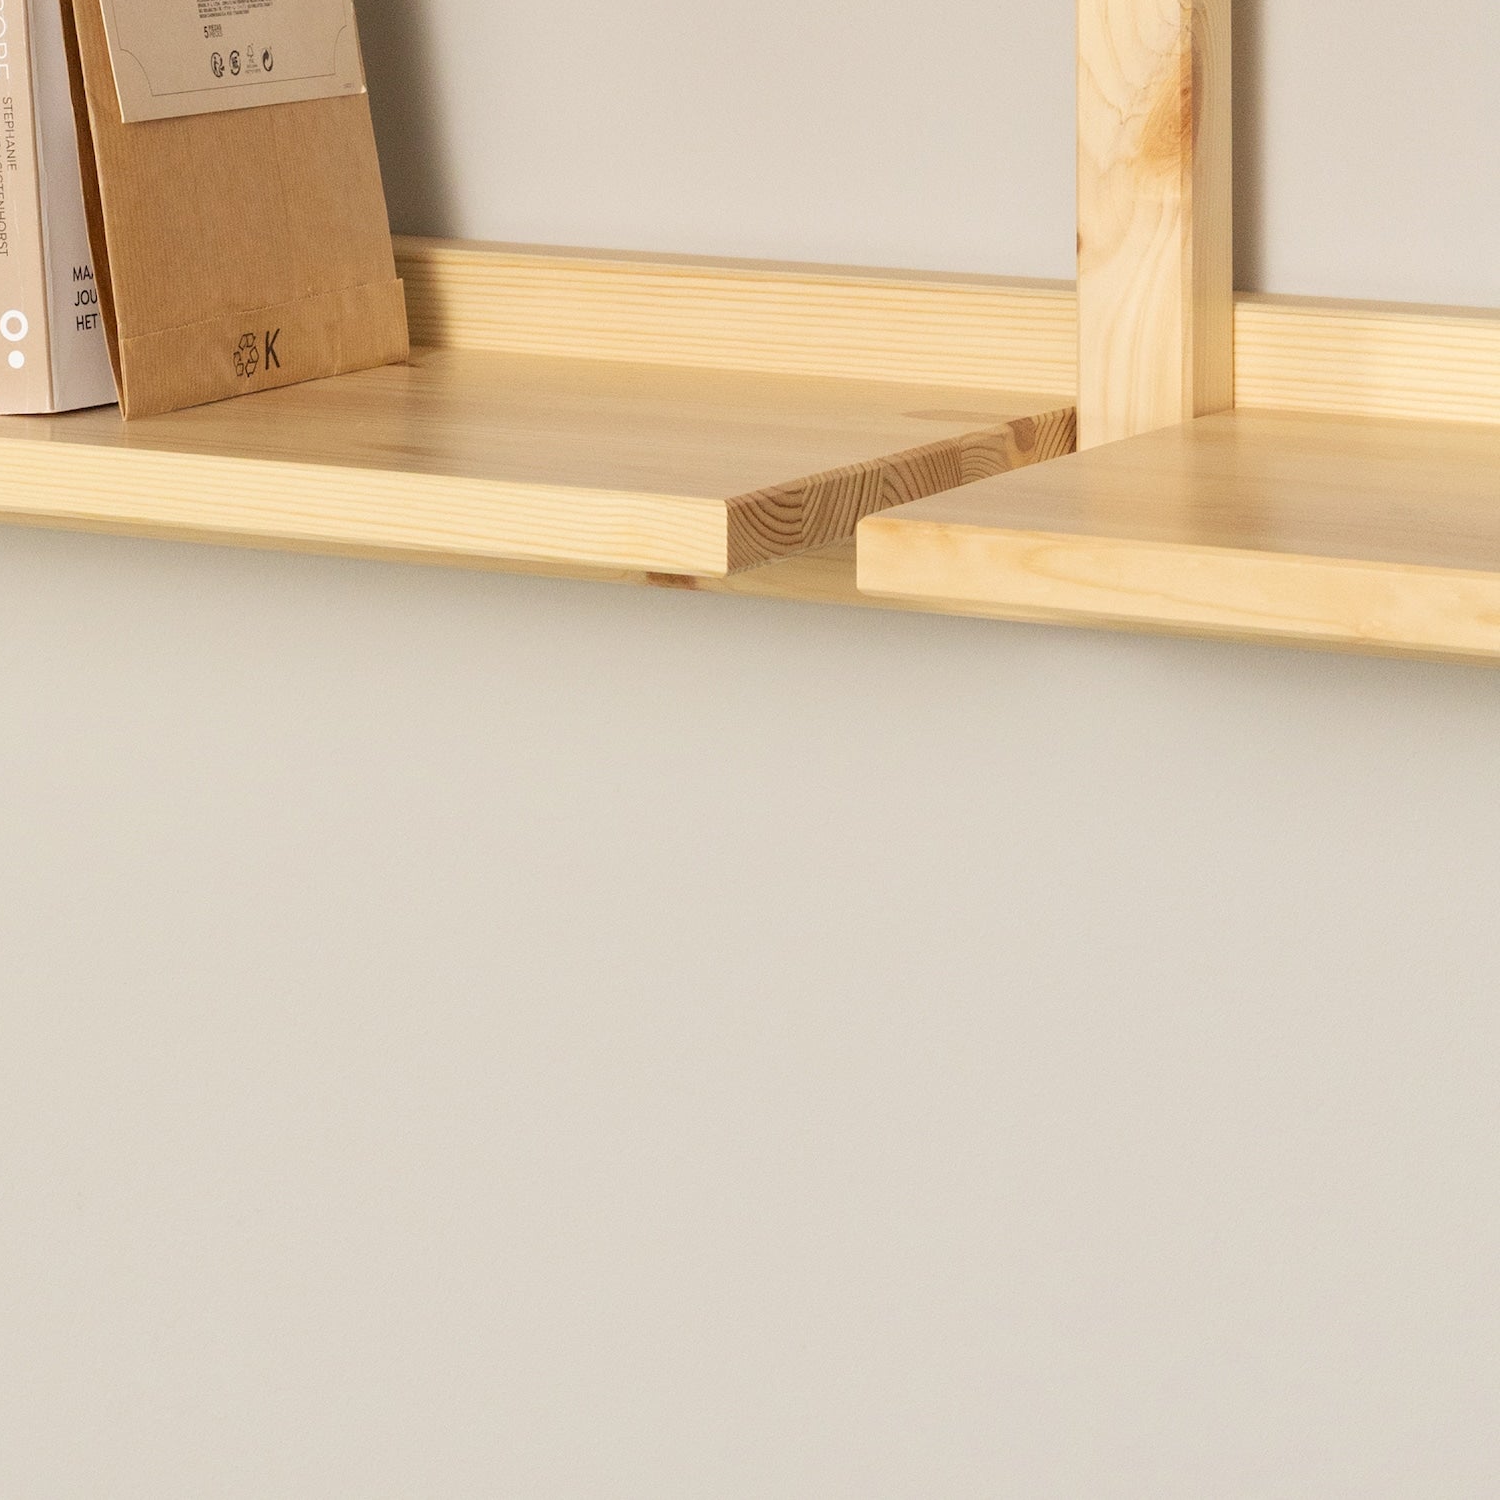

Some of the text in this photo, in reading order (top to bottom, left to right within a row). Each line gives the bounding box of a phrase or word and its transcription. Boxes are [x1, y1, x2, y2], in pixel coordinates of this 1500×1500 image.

[203, 26, 209, 39] 5
[2, 96, 17, 171] STEPHANIE
[73, 264, 93, 282] MA
[265, 328, 281, 370] K
